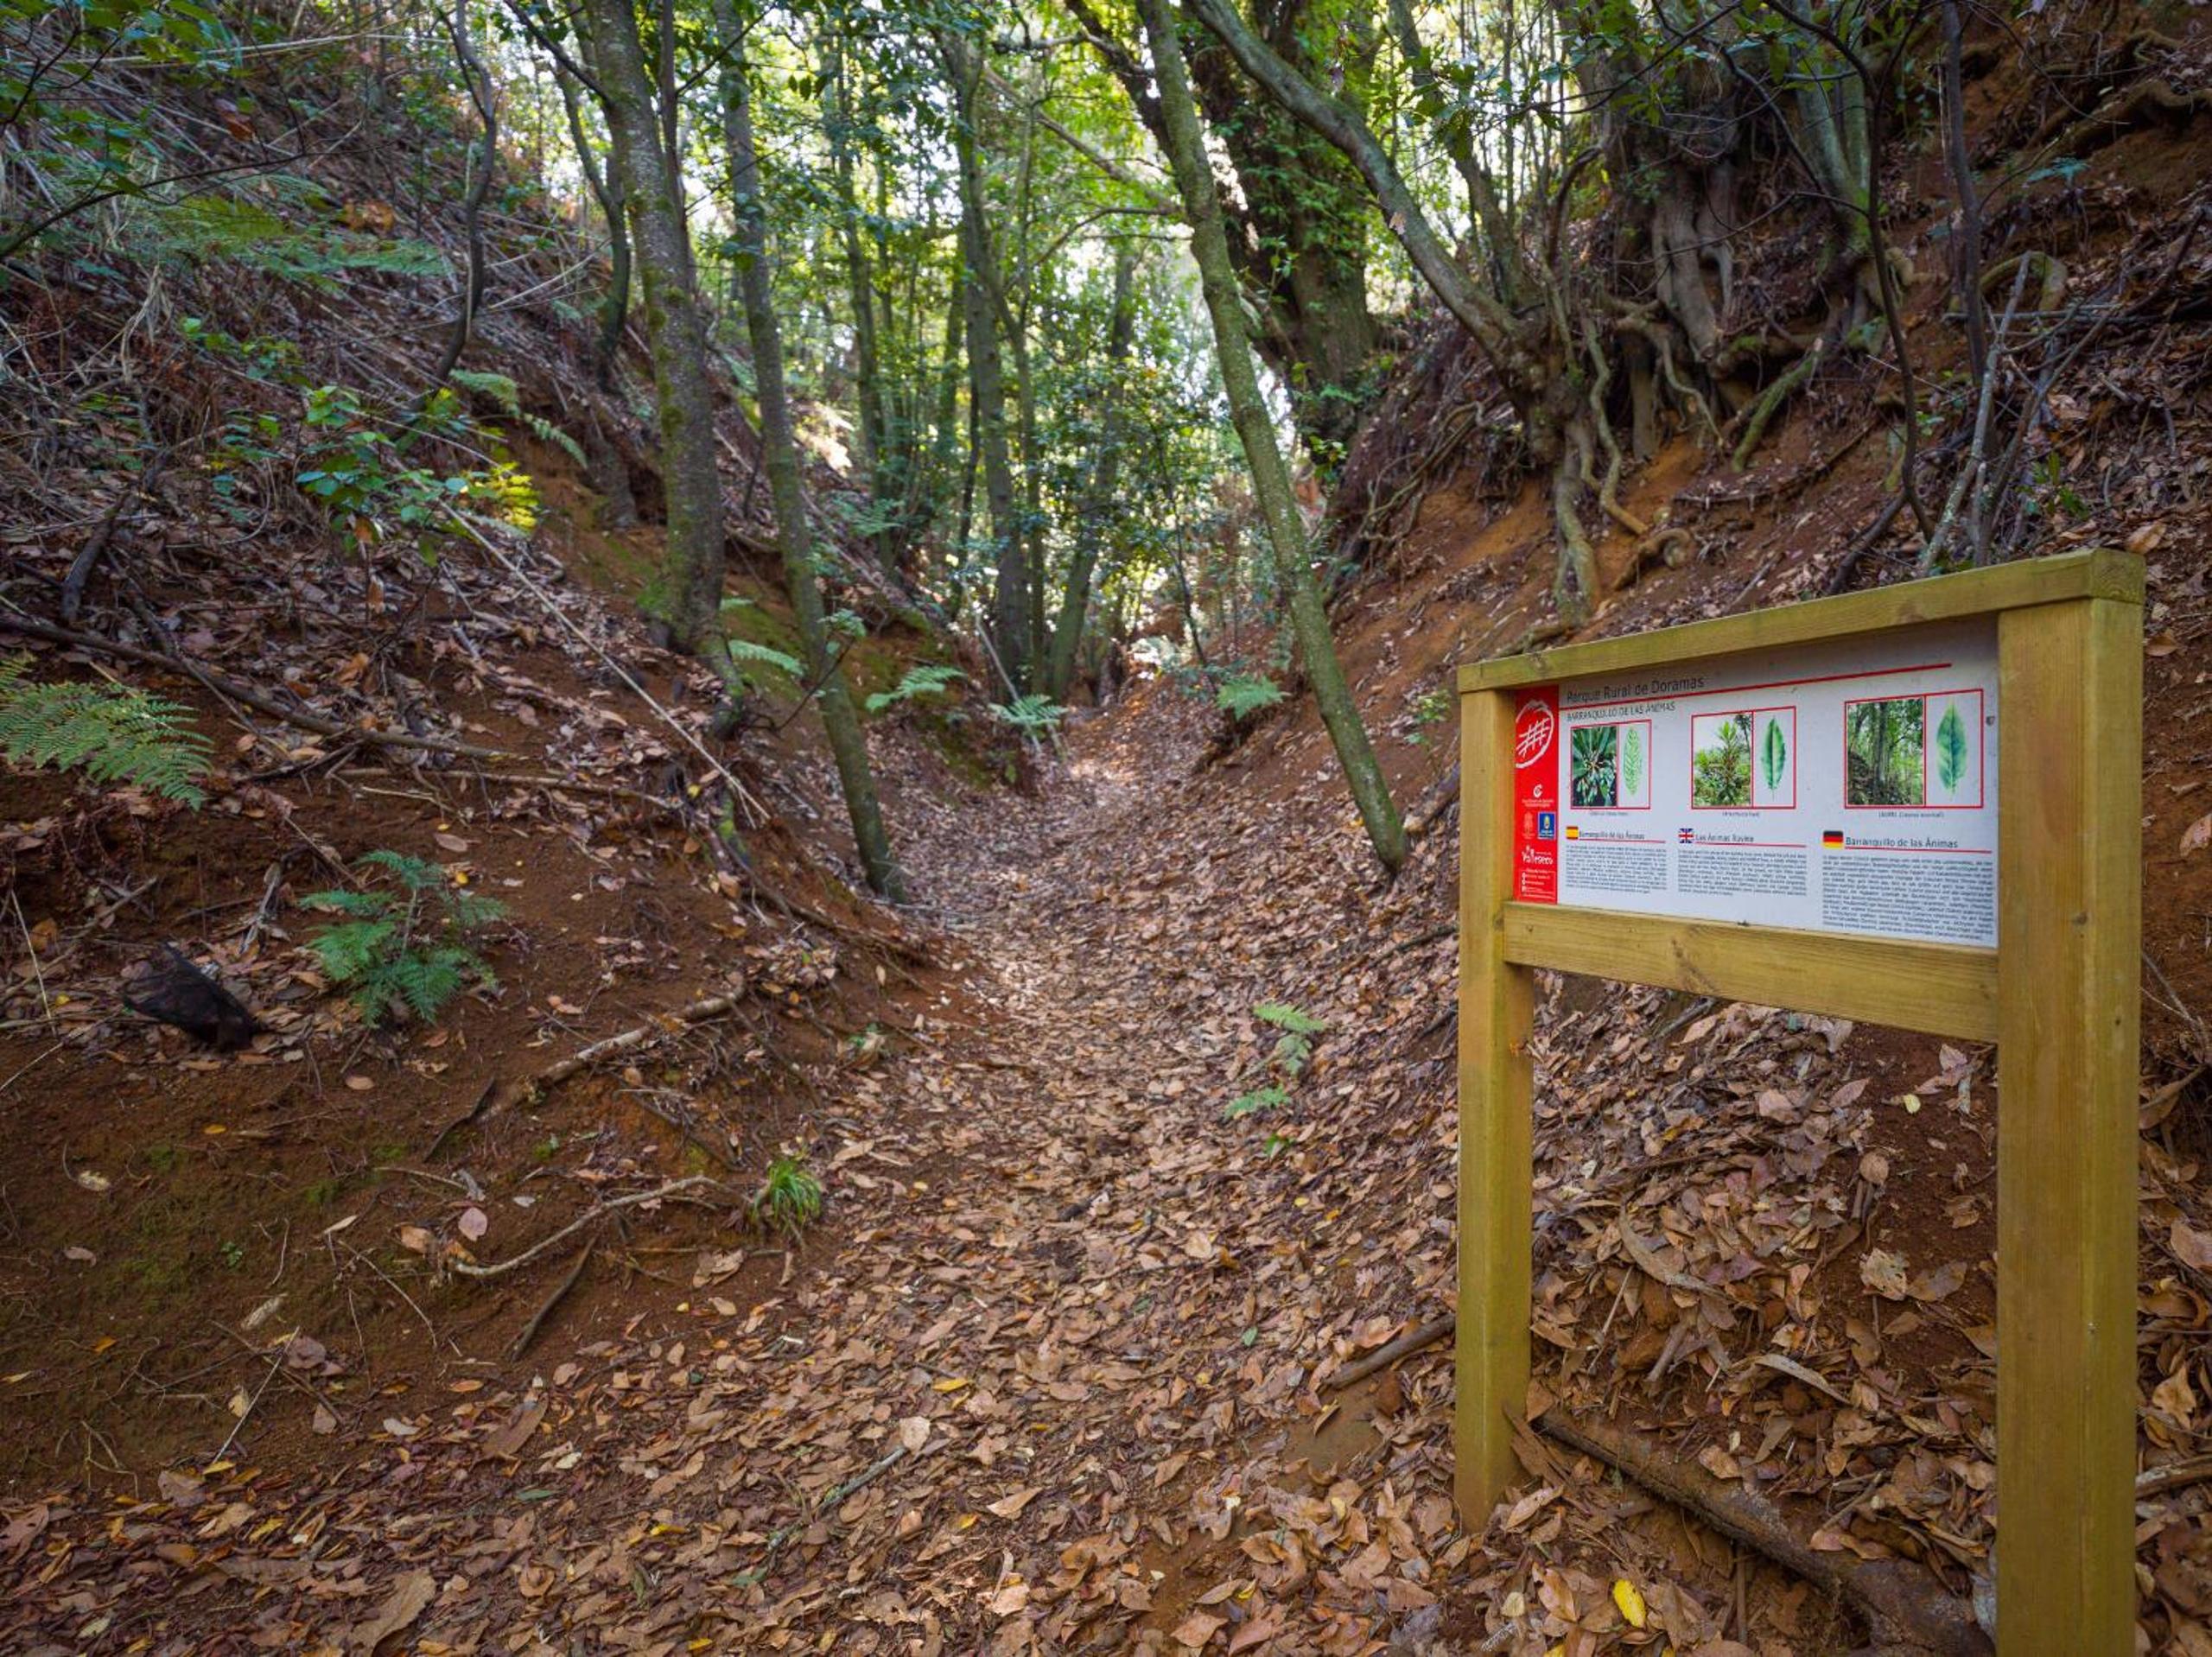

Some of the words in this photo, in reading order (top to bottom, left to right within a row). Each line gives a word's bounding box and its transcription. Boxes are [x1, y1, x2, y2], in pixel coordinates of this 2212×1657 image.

[1604, 685, 1630, 699] Rural
[1636, 683, 1649, 695] de
[1651, 677, 1705, 694] Doramas
[1618, 707, 1629, 716] DE
[1630, 705, 1643, 714] LAS
[1846, 836, 1895, 848] Barranquillo
[1910, 838, 1923, 847] las
[1926, 836, 1958, 848] Ánimas
